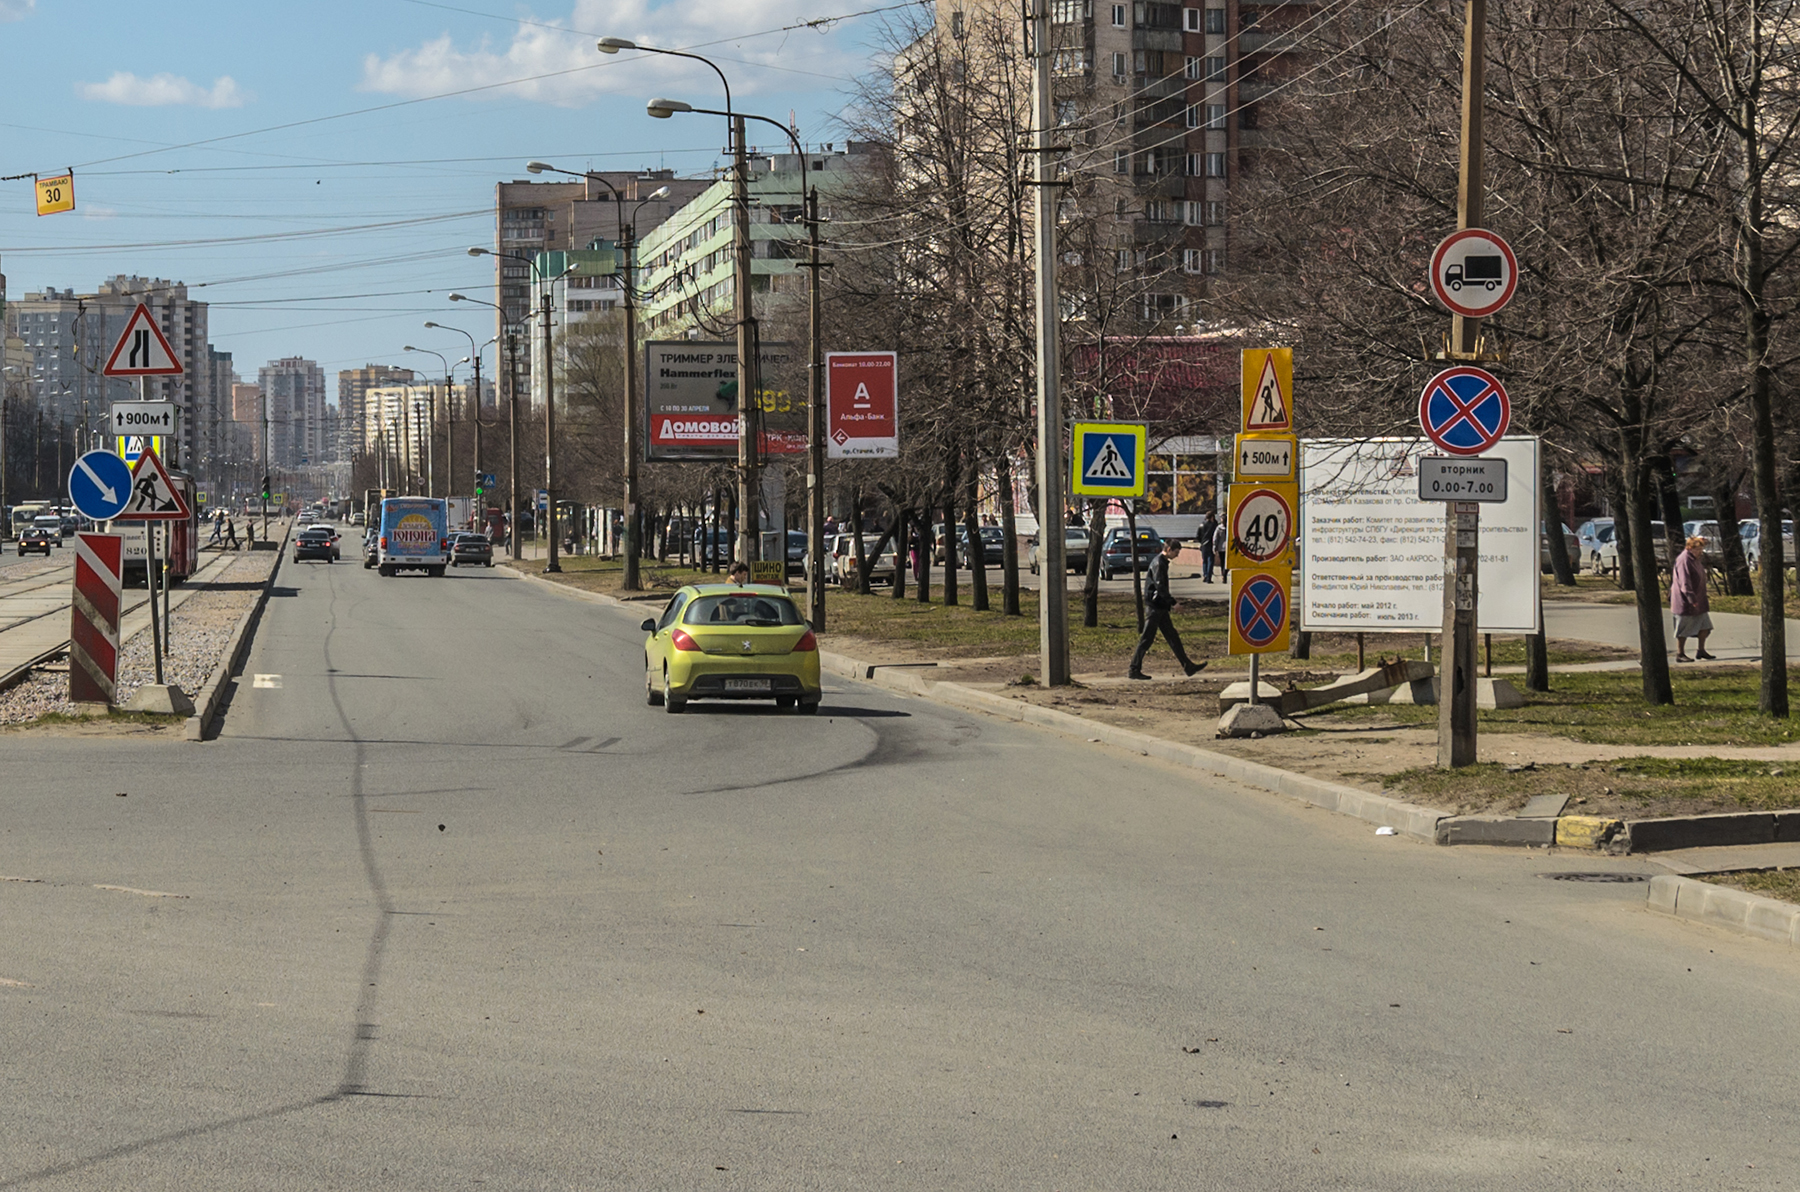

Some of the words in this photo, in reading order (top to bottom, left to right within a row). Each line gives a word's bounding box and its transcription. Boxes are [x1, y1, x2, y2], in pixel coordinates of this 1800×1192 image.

[39, 178, 68, 188] ТРАМВАЮ
[45, 187, 61, 204] 30
[660, 354, 714, 364] ТРИММЕР
[660, 368, 736, 378] Hammerflex
[854, 382, 870, 400] А
[126, 413, 160, 425] 900м
[1252, 451, 1279, 464] 500м
[1441, 466, 1485, 476] вторник
[1432, 480, 1494, 493] 0.00-7.00
[1354, 497, 1383, 505] Казакова
[1394, 498, 1403, 506] пр.
[1343, 516, 1365, 525] работ:
[1246, 514, 1279, 543] 40
[1312, 525, 1364, 534] инфраструктуры
[1327, 536, 1343, 544] (812)
[1400, 536, 1417, 544] (812)
[1312, 555, 1364, 563] Производитель
[1366, 554, 1389, 563] работ:
[1479, 555, 1508, 563] 02-81-81
[754, 562, 782, 573] ШИНО
[1312, 573, 1364, 581] Ответственный
[1312, 583, 1348, 591] Венедиктов
[1350, 583, 1368, 591] Юрий
[1312, 601, 1336, 609] Начало
[1338, 601, 1360, 610] работ:
[1361, 601, 1374, 609] май
[1312, 611, 1348, 619] Окончание
[1350, 611, 1372, 620] работ:
